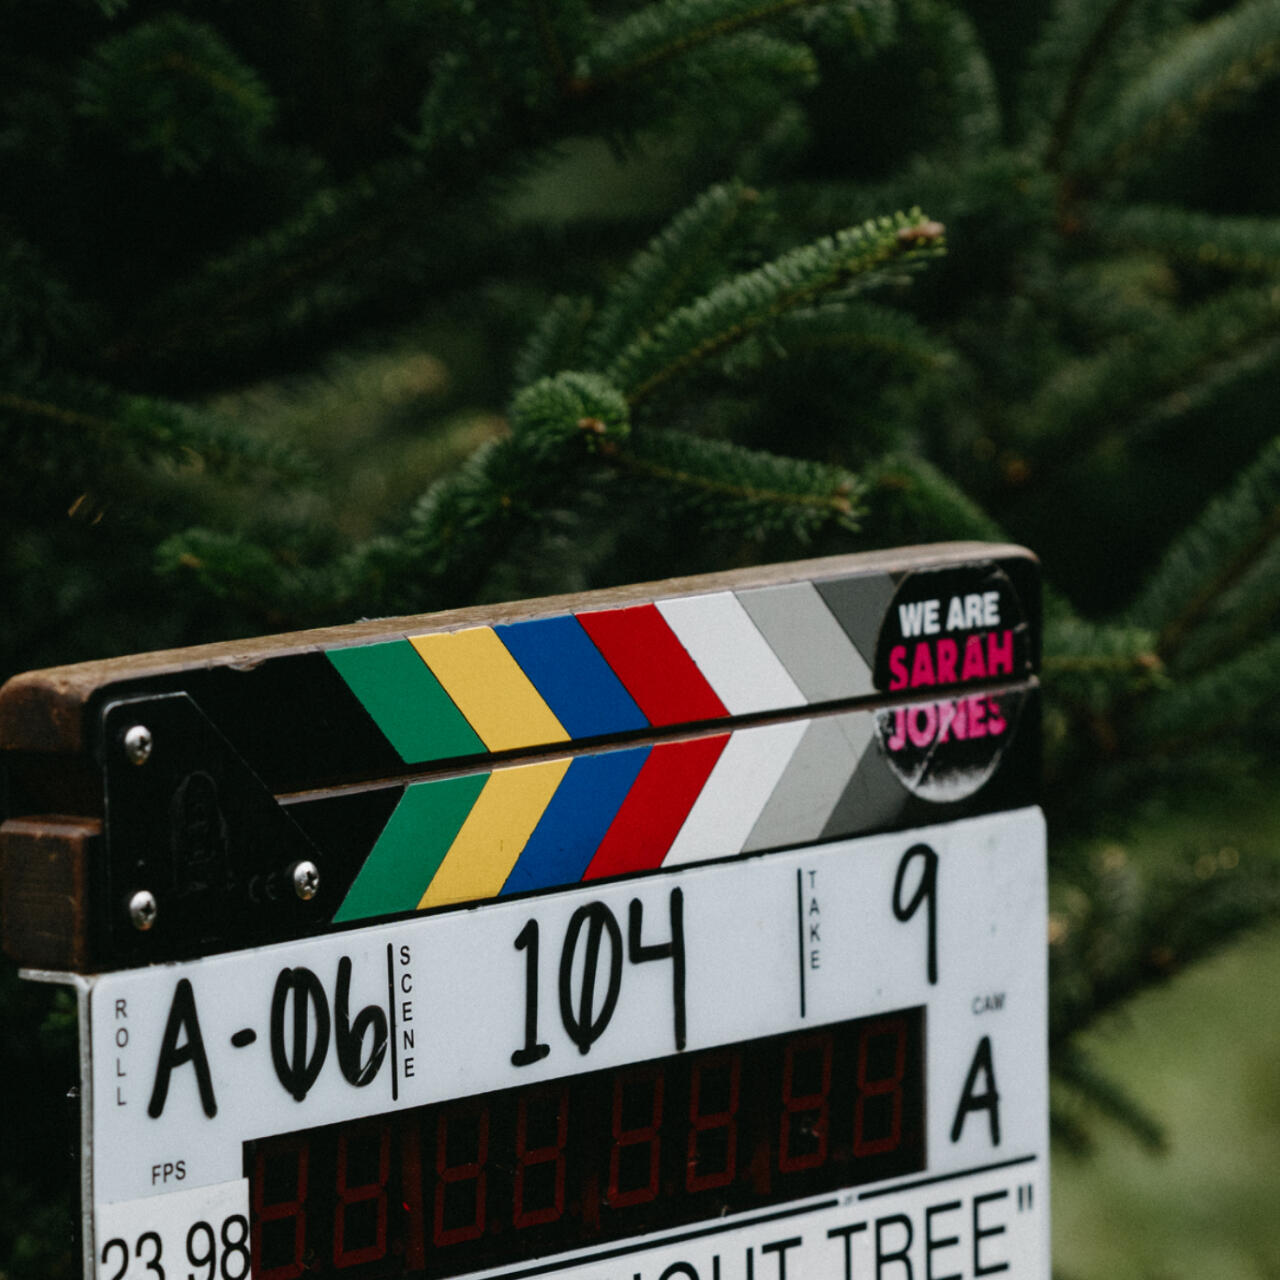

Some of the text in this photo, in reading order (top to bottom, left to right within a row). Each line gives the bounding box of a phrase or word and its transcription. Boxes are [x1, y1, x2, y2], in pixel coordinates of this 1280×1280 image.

[888, 630, 1014, 691] SARAH
[898, 591, 1000, 638] WE ARE
[888, 693, 1007, 751] JONES
[808, 870, 820, 969] TAKE
[892, 843, 939, 985] 9
[400, 946, 415, 1078] SCENE
[511, 887, 686, 1066] 104
[971, 992, 1006, 1015] CAM
[115, 999, 129, 1106] ROLL
[147, 955, 388, 1119] A-06
[950, 1035, 1001, 1147] A
[152, 1160, 187, 1186] FPS
